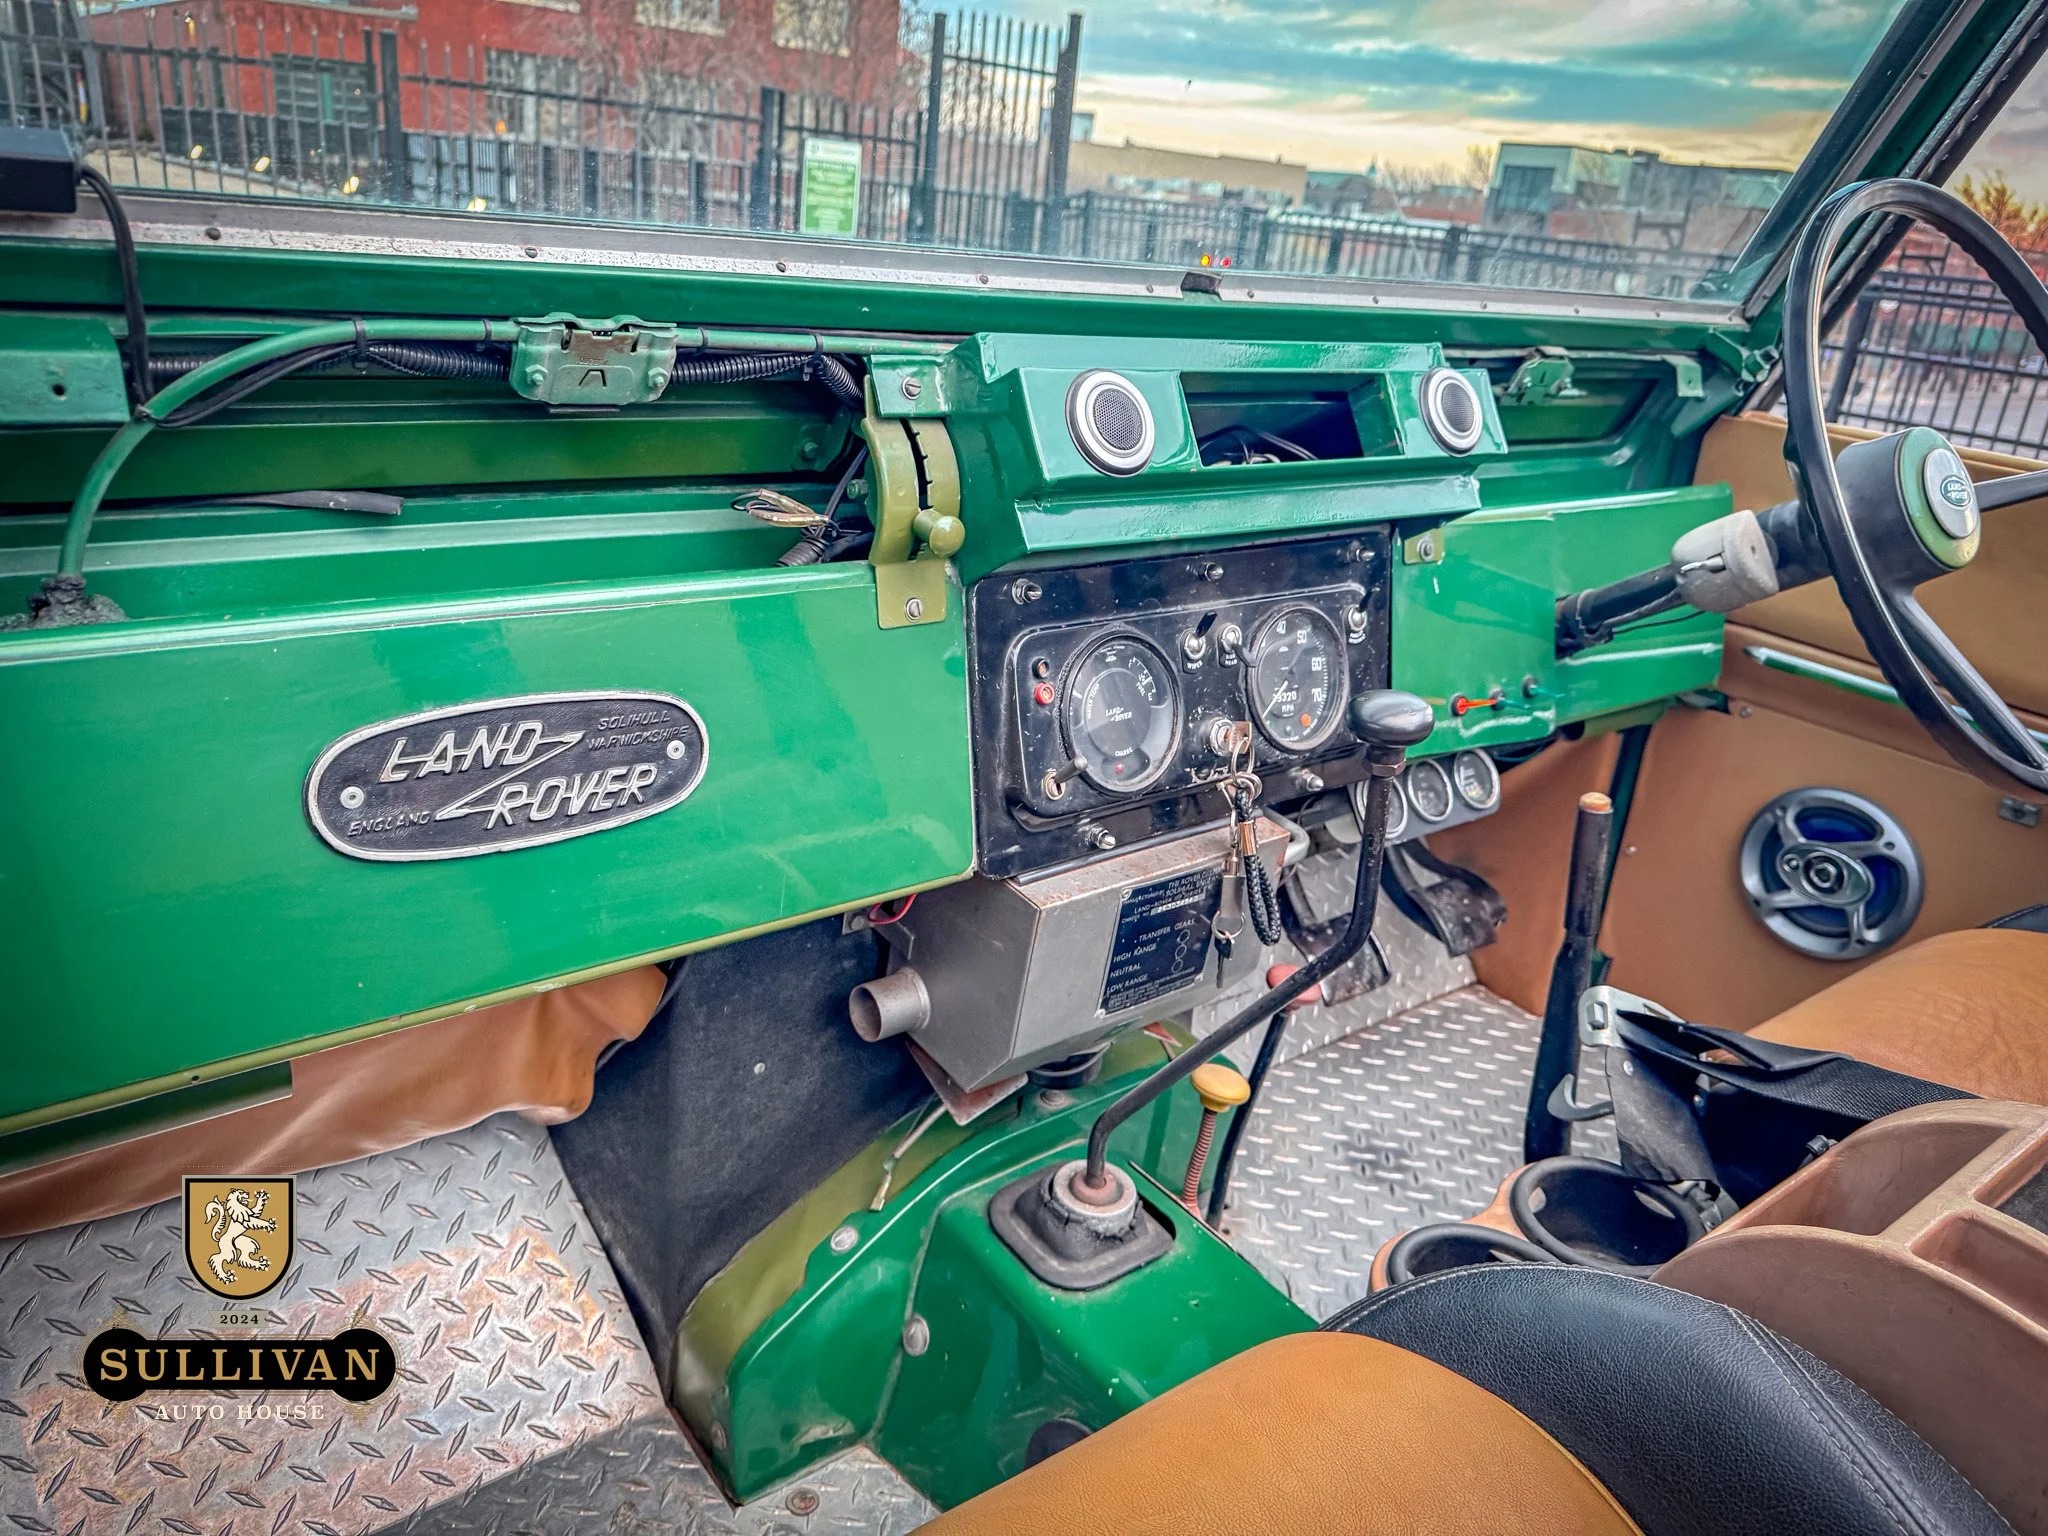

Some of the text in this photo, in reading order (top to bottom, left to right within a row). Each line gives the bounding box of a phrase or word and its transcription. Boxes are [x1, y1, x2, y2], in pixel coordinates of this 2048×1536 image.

[1276, 620, 1286, 634] 40
[1297, 630, 1307, 644] 50
[1311, 657, 1322, 671] 60
[1312, 688, 1322, 702] 70
[1282, 704, 1294, 712] MPH
[597, 710, 671, 731] SOLIHULL
[379, 722, 549, 784] LAND
[485, 762, 659, 830] ROVER
[347, 811, 430, 837] ENGLAND
[1139, 927, 1170, 942] TRANSFER
[1113, 943, 1157, 963] HIGH RANGE
[1110, 963, 1141, 978] NEUTRAL
[1106, 982, 1123, 993] LOW
[1124, 974, 1148, 987] RANGE
